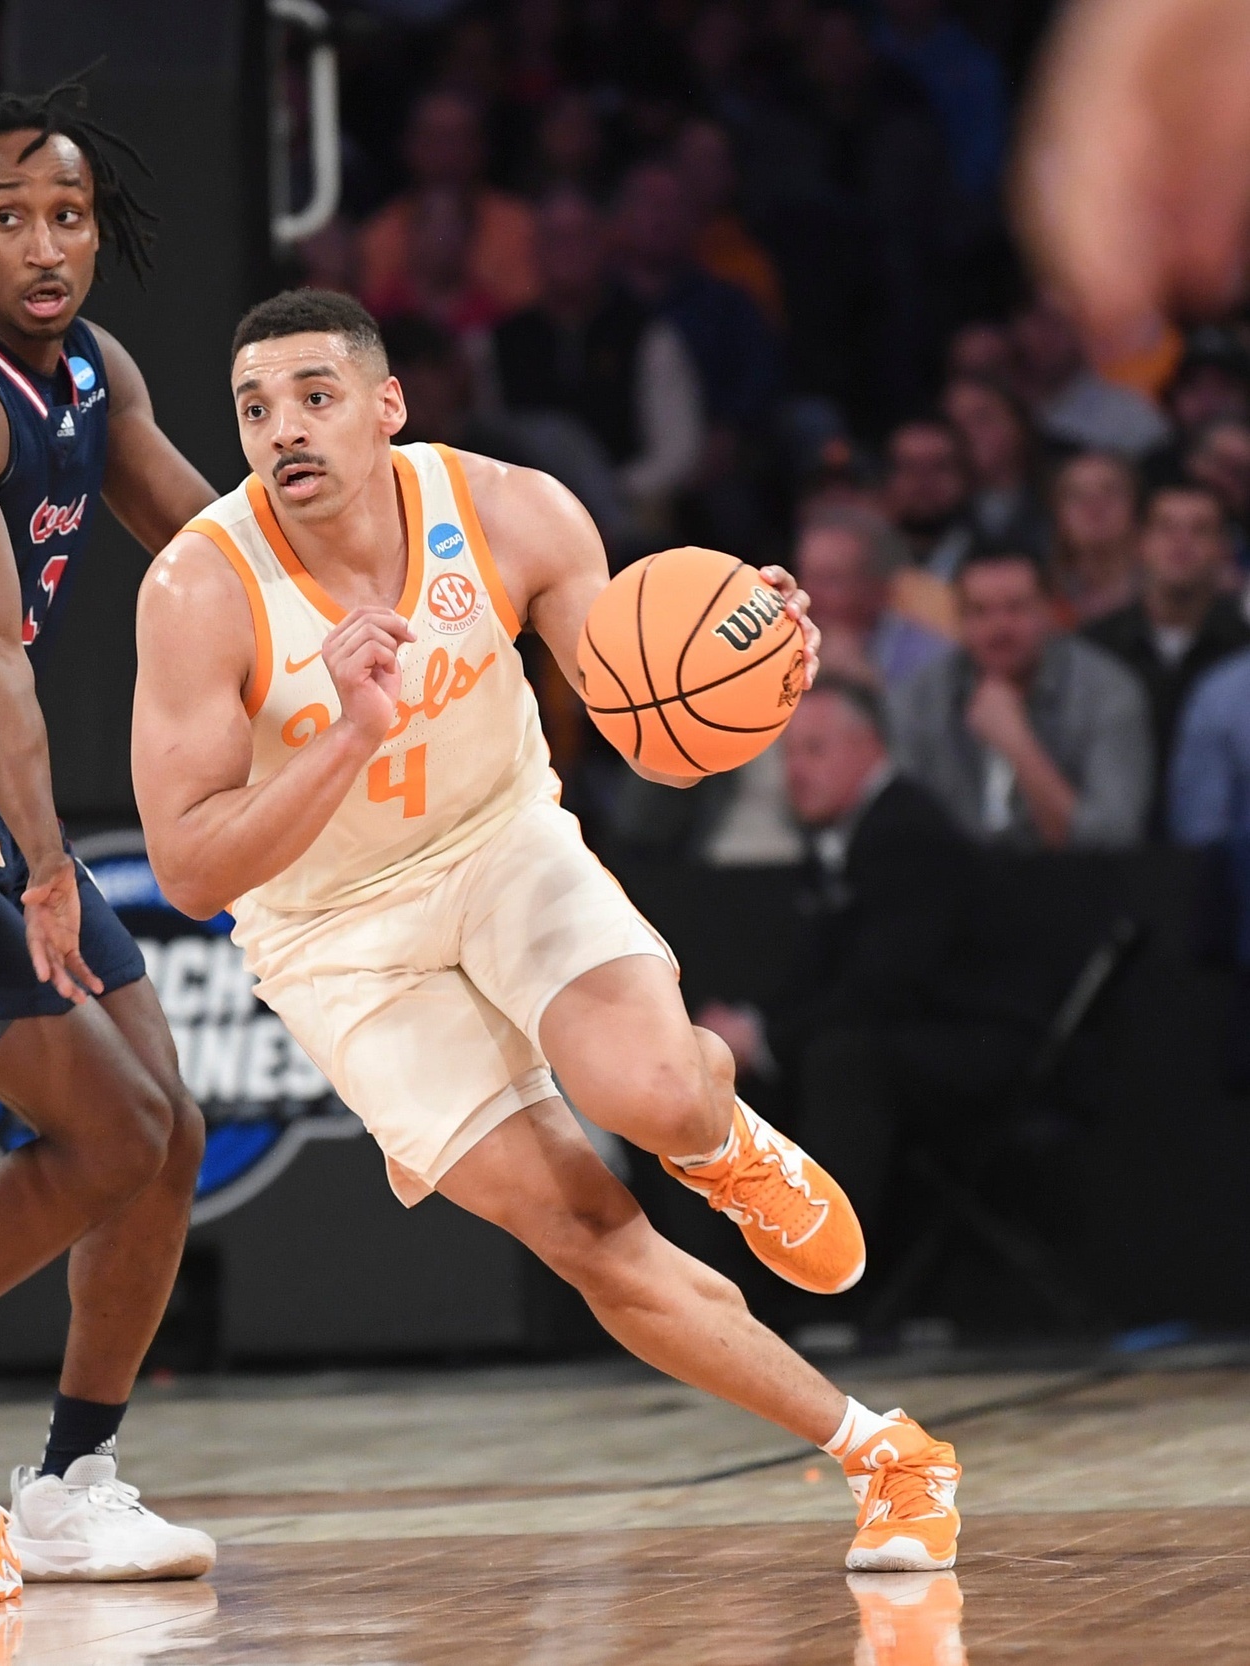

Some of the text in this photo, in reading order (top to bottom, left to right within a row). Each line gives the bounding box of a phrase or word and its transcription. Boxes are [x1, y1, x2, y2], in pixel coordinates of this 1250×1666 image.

[435, 533, 463, 554] NCAA
[431, 576, 472, 617] SEC
[439, 603, 484, 632] GRADUATE
[711, 586, 787, 651] Wils
[367, 743, 426, 819] 4
